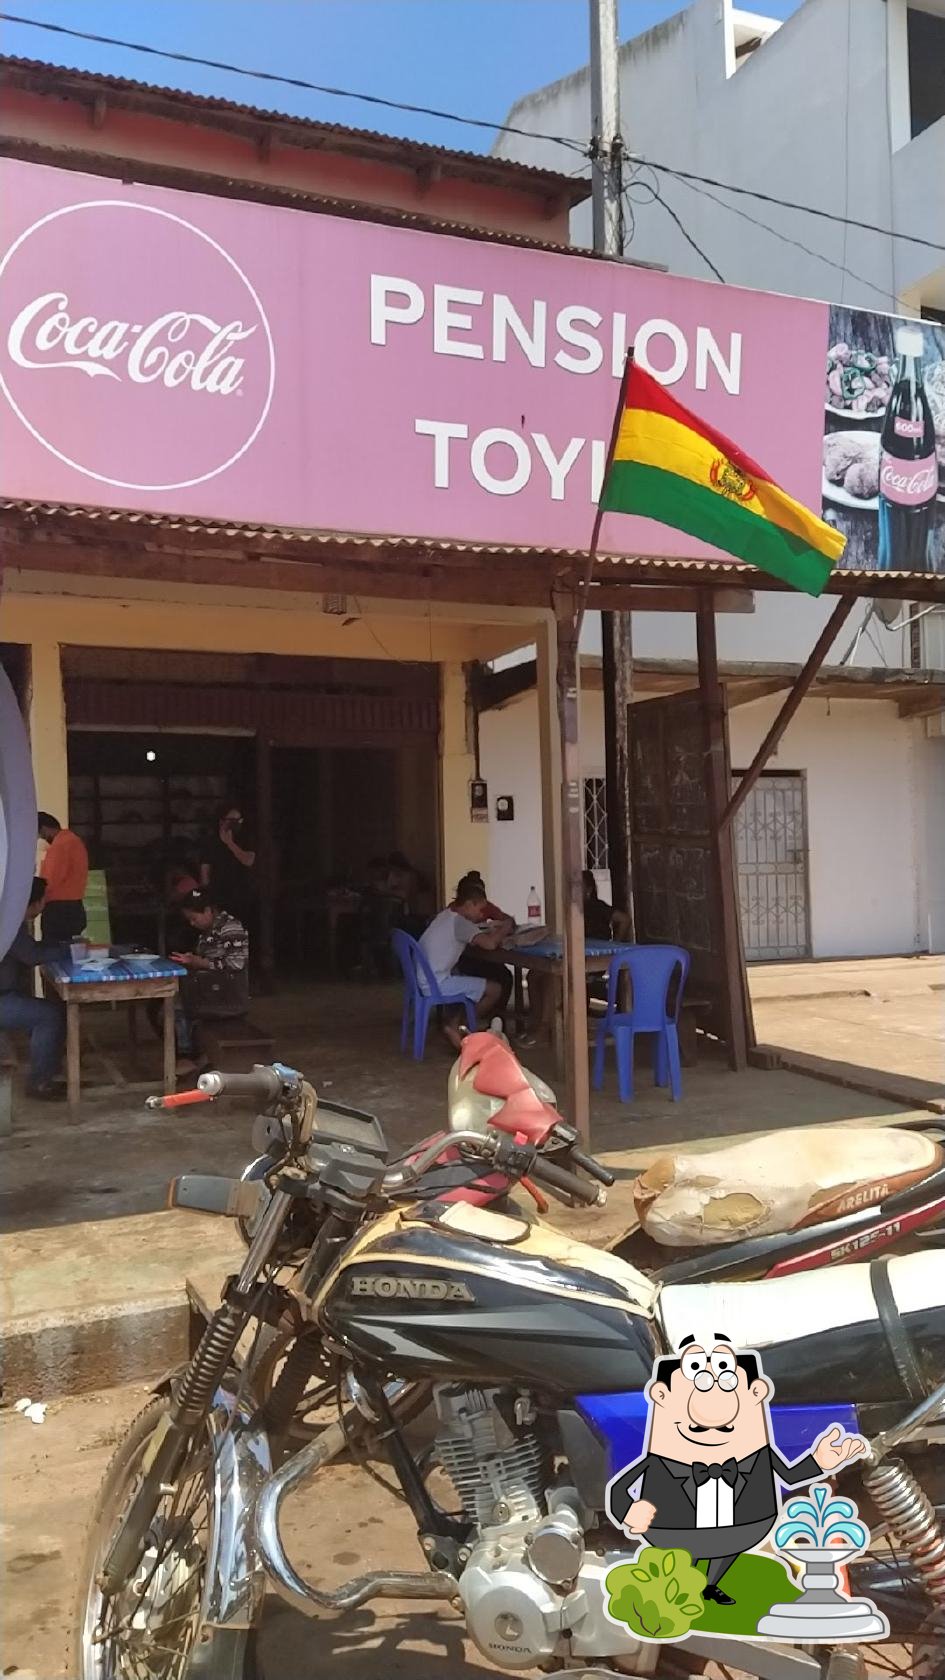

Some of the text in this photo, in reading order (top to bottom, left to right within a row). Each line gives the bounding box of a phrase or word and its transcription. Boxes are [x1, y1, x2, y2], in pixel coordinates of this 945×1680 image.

[7, 292, 257, 396] Coca-Cola
[369, 273, 742, 395] PENSION
[352, 1276, 475, 1301] HONDA
[488, 1642, 532, 1654] HONDA
